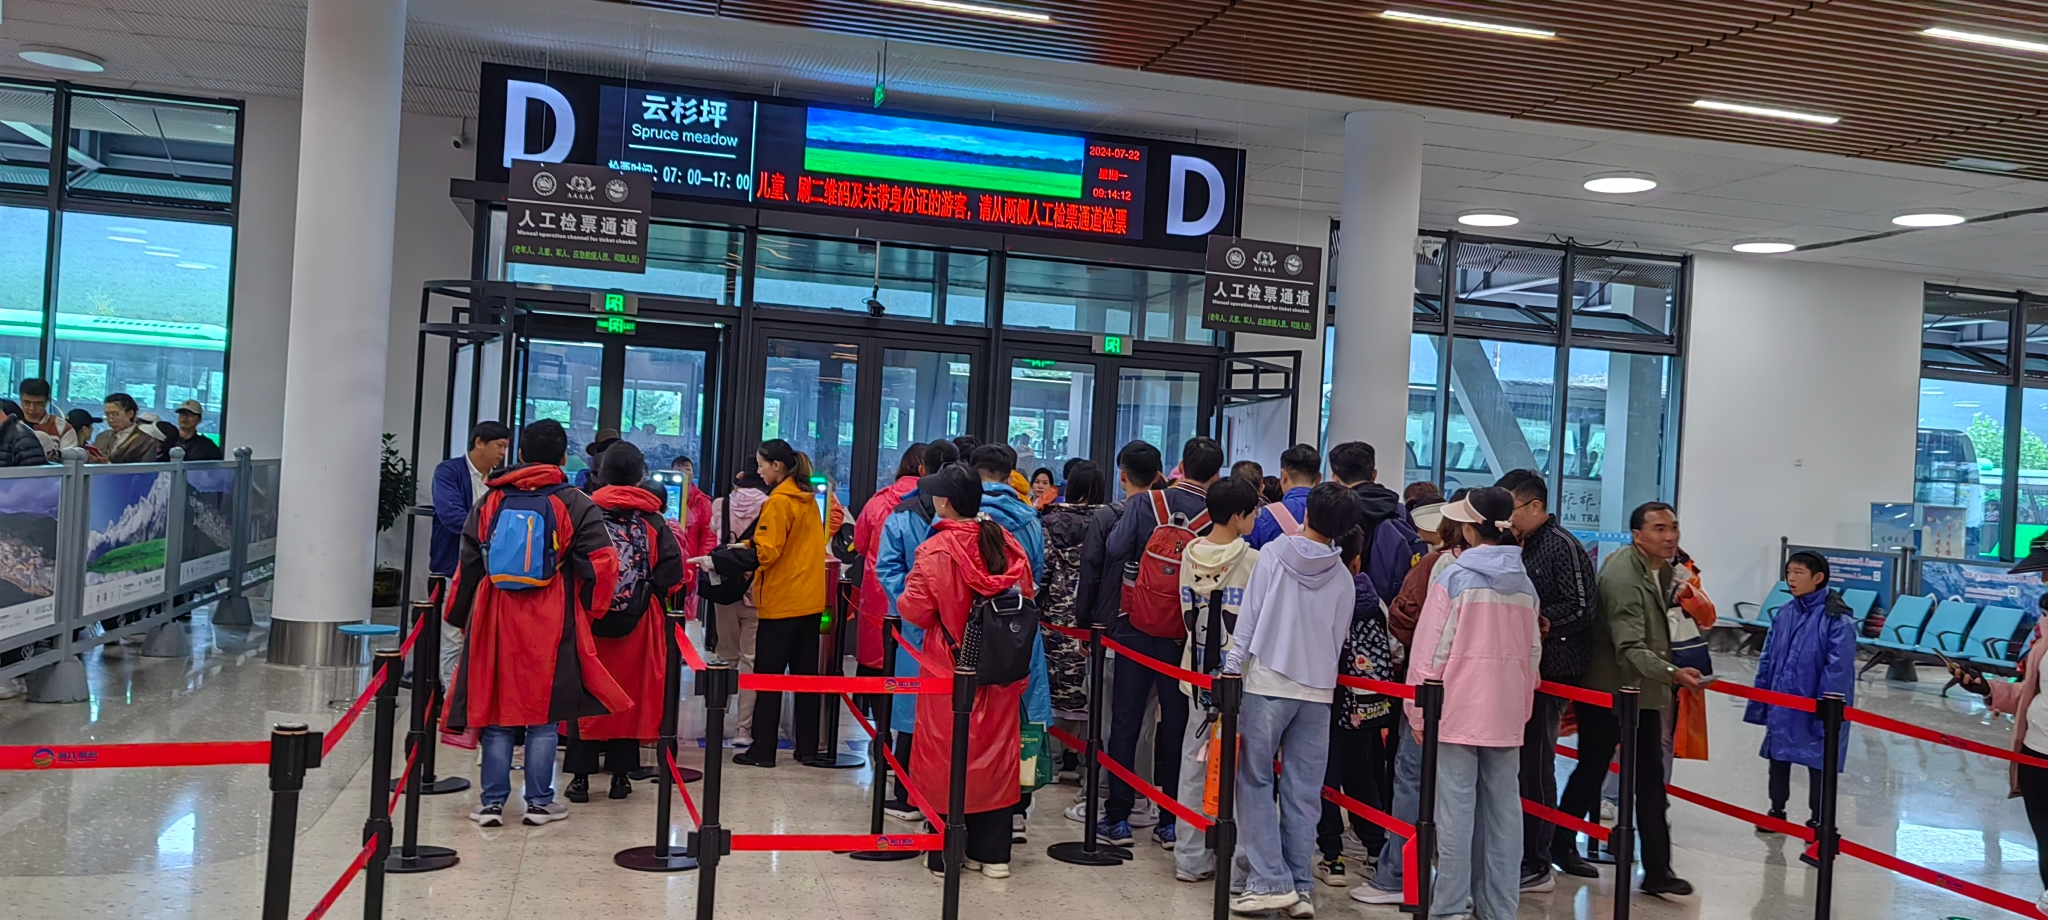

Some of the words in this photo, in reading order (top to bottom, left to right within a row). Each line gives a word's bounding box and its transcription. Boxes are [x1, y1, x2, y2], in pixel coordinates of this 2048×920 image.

[503, 79, 576, 168] D
[641, 94, 728, 129] 云杉坪
[631, 123, 679, 142] Spruce
[682, 129, 738, 147] meadow
[1089, 145, 1140, 161] 2024-07-22
[1098, 167, 1129, 181] 星期一
[1092, 187, 1132, 201] 09:14:12
[1166, 154, 1226, 236] D
[516, 229, 538, 237] Manual
[539, 231, 567, 239] operation
[518, 209, 638, 237] 人工检票通道
[1213, 281, 1311, 306] 人工检票通道
